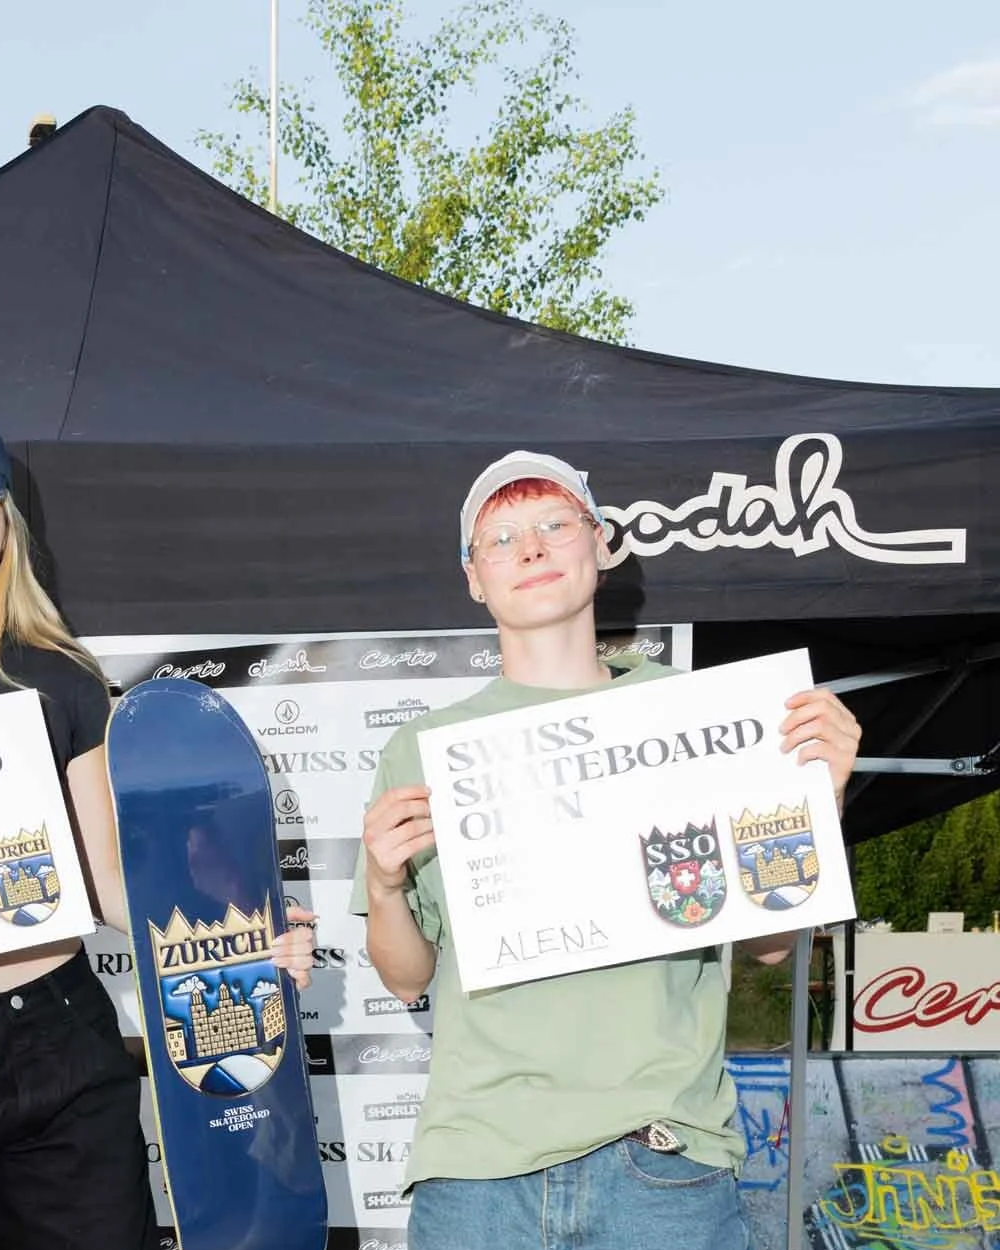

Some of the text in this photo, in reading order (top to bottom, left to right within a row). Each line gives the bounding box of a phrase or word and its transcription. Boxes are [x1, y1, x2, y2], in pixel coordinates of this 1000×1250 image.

[600, 433, 967, 570] oodah
[359, 648, 438, 670] Certo
[257, 726, 319, 736] VOLCOM
[262, 751, 348, 774] WISS
[459, 791, 585, 841] ON
[646, 833, 717, 866] SSO
[159, 927, 271, 969] ZÜRICH
[496, 919, 609, 966] ALENA
[853, 966, 1000, 1033] Cer
[209, 1109, 270, 1128] SKATEBOARD
[224, 1105, 254, 1118] SWISS
[228, 1121, 254, 1132] OPEN
